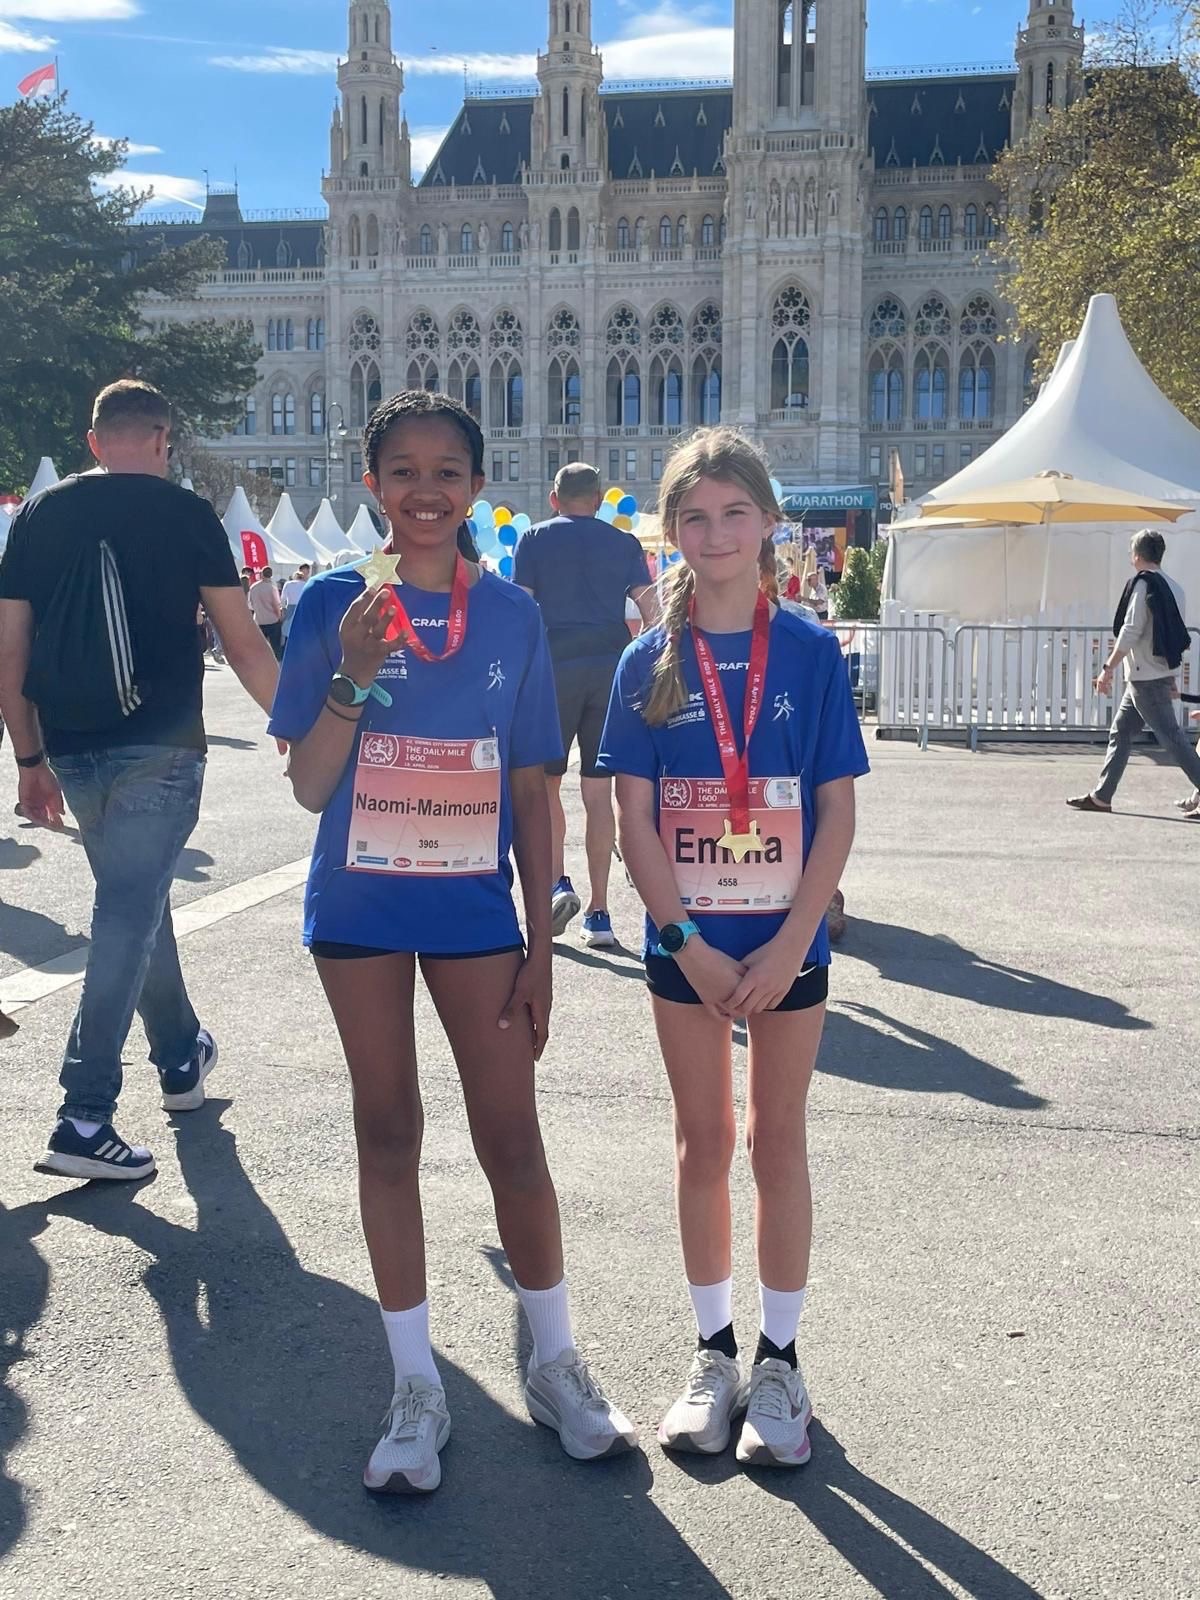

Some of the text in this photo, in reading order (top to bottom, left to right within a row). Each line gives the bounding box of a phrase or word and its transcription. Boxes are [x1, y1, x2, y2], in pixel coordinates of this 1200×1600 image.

[792, 495, 863, 507] MARATHON
[707, 678, 718, 696] MILE
[751, 686, 759, 704] April
[712, 697, 723, 719] DAILY
[718, 720, 728, 735] THE
[406, 745, 465, 757] THE DAILY MILE
[405, 754, 426, 762] 1600
[748, 786, 757, 794] LE
[698, 794, 718, 802] 1600
[355, 792, 497, 817] Naomi-Maimouna
[418, 839, 439, 849] 3905
[675, 828, 783, 864] Emia
[717, 878, 738, 887] 4558
